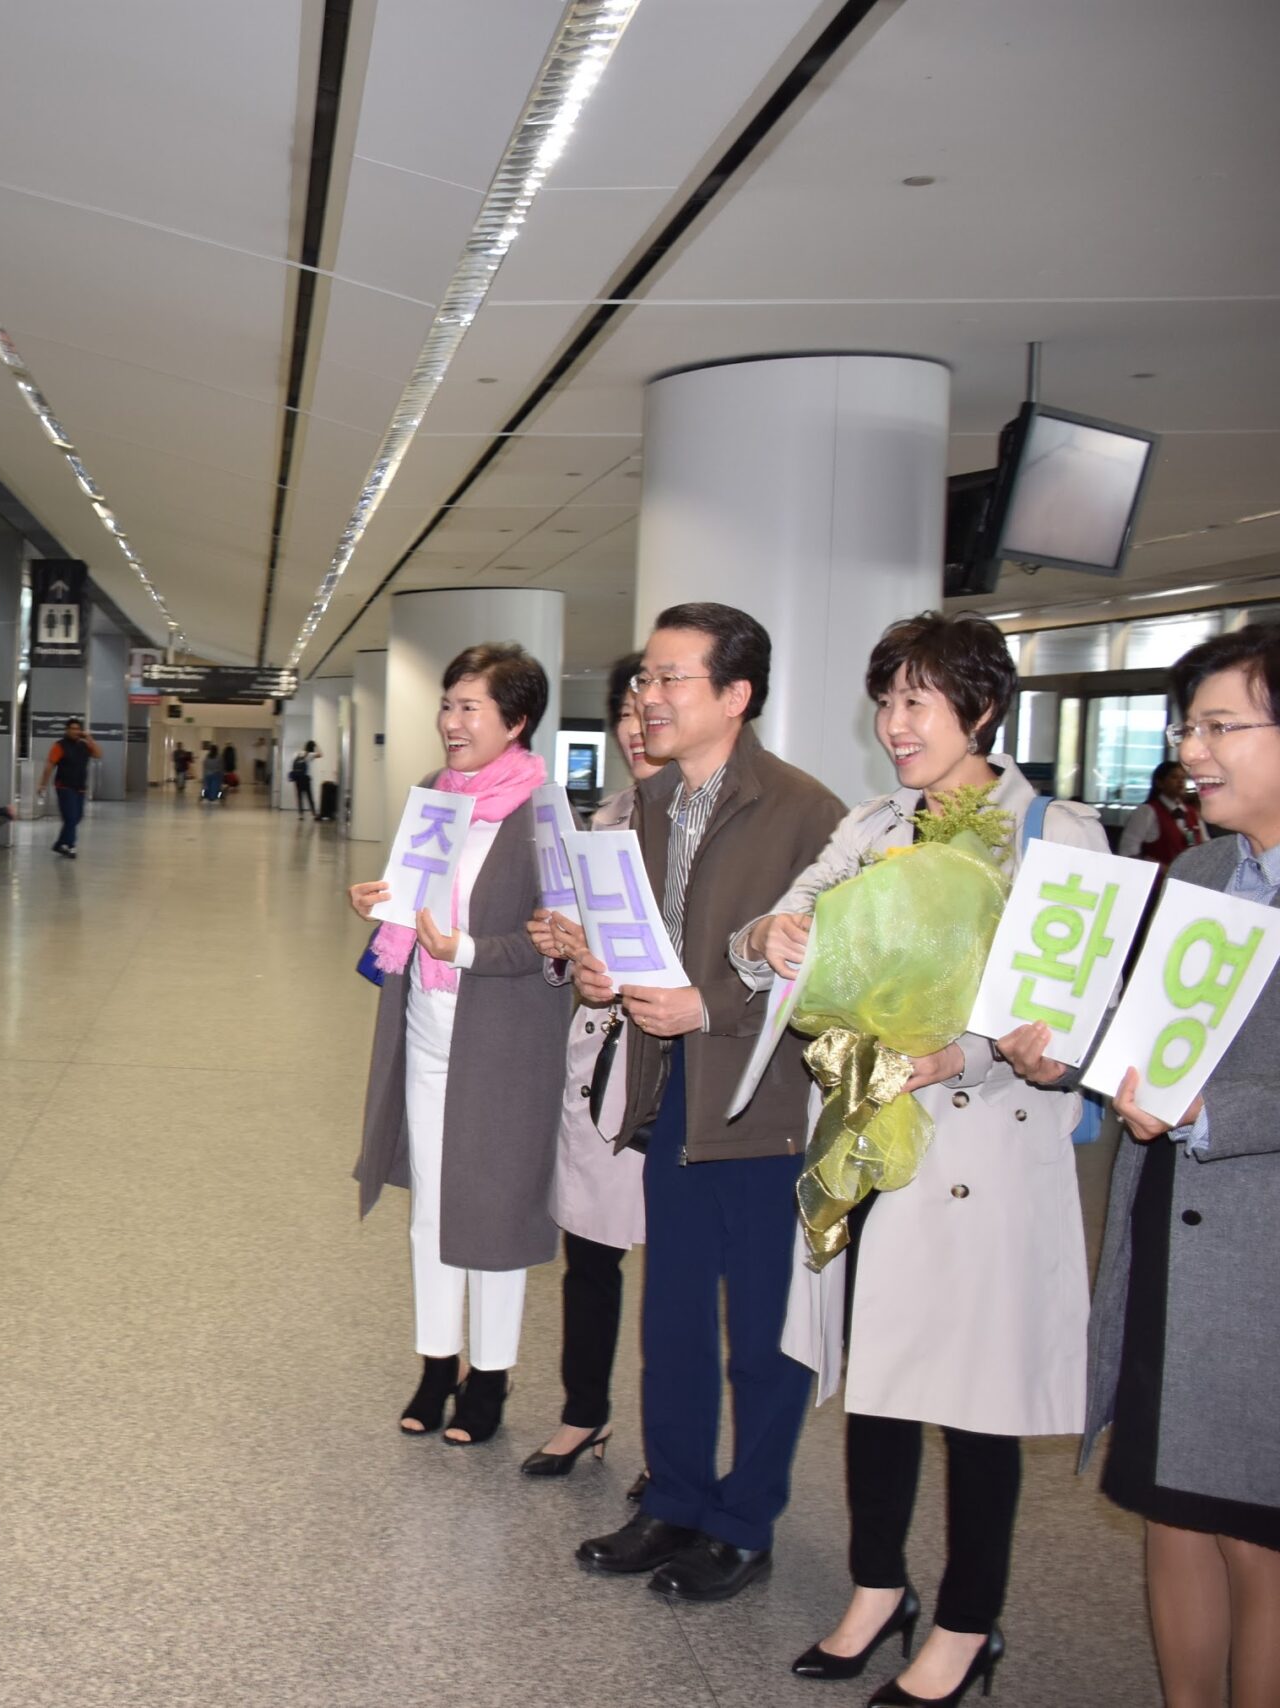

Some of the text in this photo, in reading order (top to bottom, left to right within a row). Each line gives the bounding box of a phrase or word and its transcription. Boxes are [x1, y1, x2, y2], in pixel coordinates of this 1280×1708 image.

[402, 803, 456, 911] 주
[536, 805, 577, 907] 교
[577, 850, 667, 972] 님
[1010, 873, 1120, 1034] 환
[1147, 918, 1265, 1089] 영
